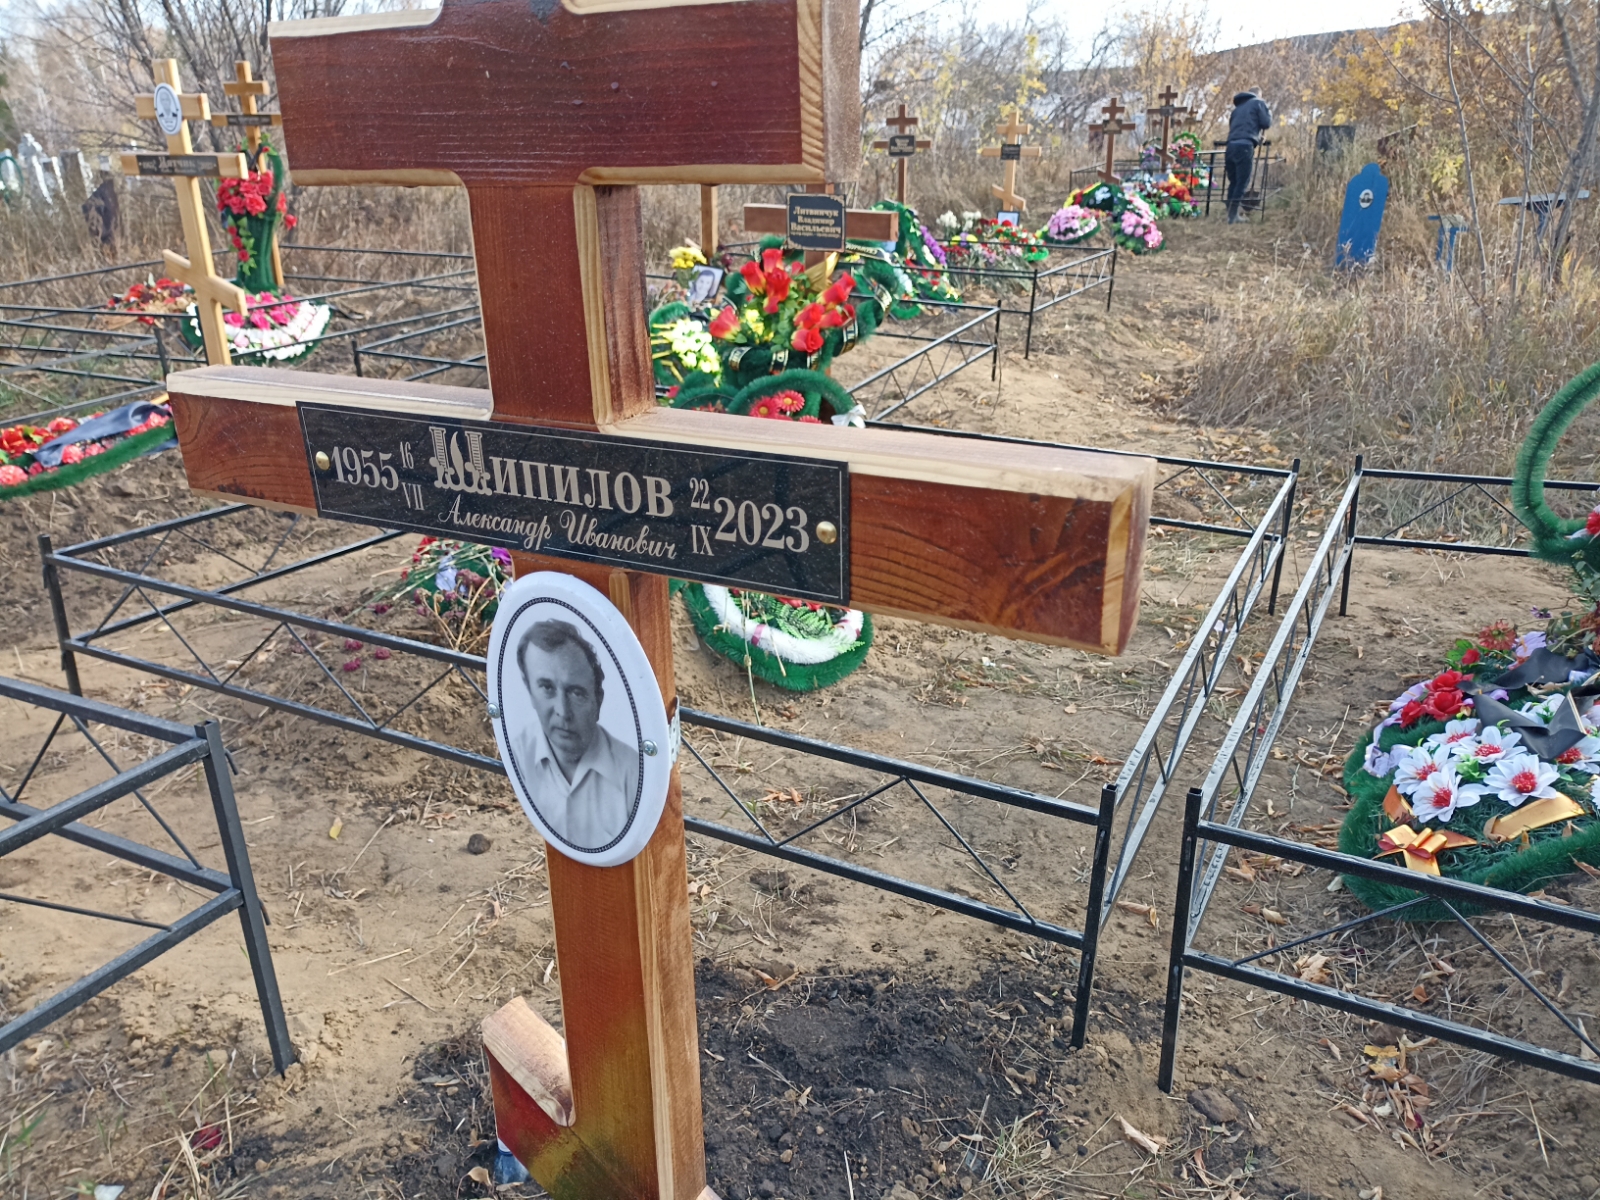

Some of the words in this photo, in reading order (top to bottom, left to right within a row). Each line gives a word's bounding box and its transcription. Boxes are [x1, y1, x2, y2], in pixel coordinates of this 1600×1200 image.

[791, 222, 841, 234] Васильевич
[331, 446, 399, 491] 1955
[400, 441, 414, 470] 16
[402, 481, 425, 511] VII
[689, 477, 711, 510] 22
[438, 493, 553, 551] Александр
[559, 509, 677, 560] Иванович
[690, 524, 715, 557] IX
[713, 497, 810, 553] 2023
